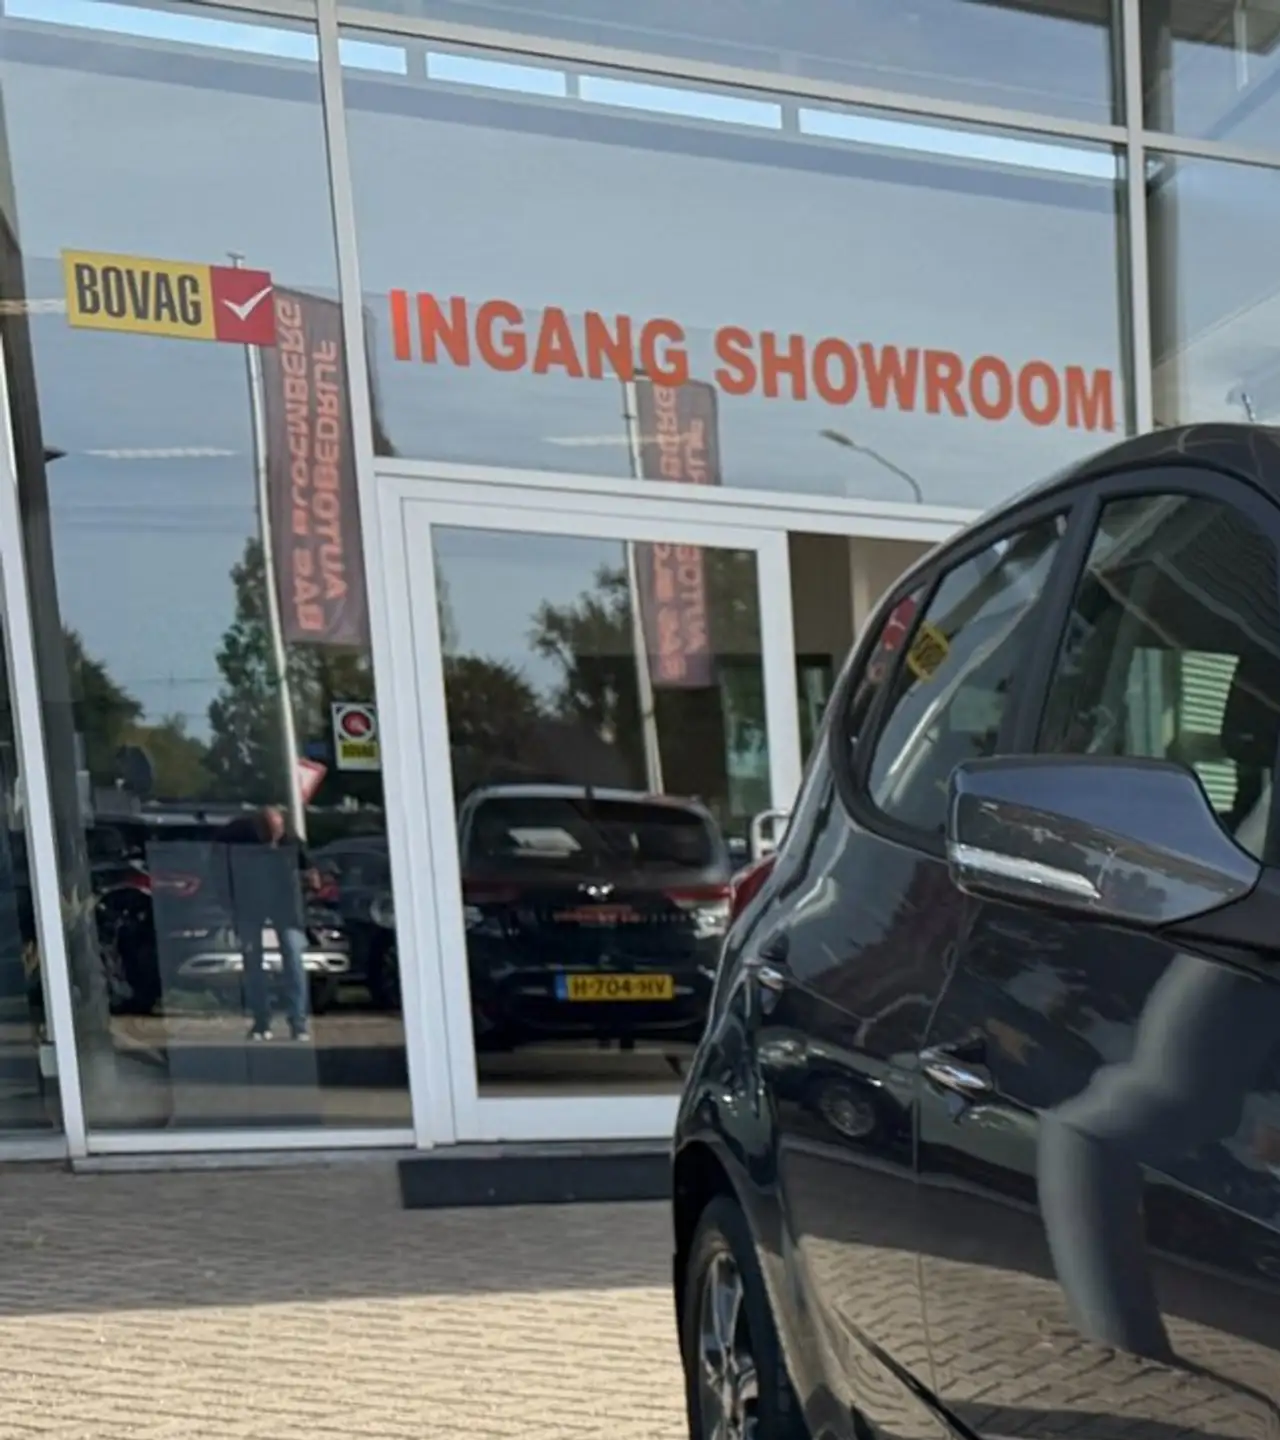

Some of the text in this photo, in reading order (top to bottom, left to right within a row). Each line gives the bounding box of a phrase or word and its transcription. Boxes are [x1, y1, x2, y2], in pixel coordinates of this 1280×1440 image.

[75, 262, 202, 326] BOVAG
[389, 288, 1116, 433] INGANG SHOWROOM
